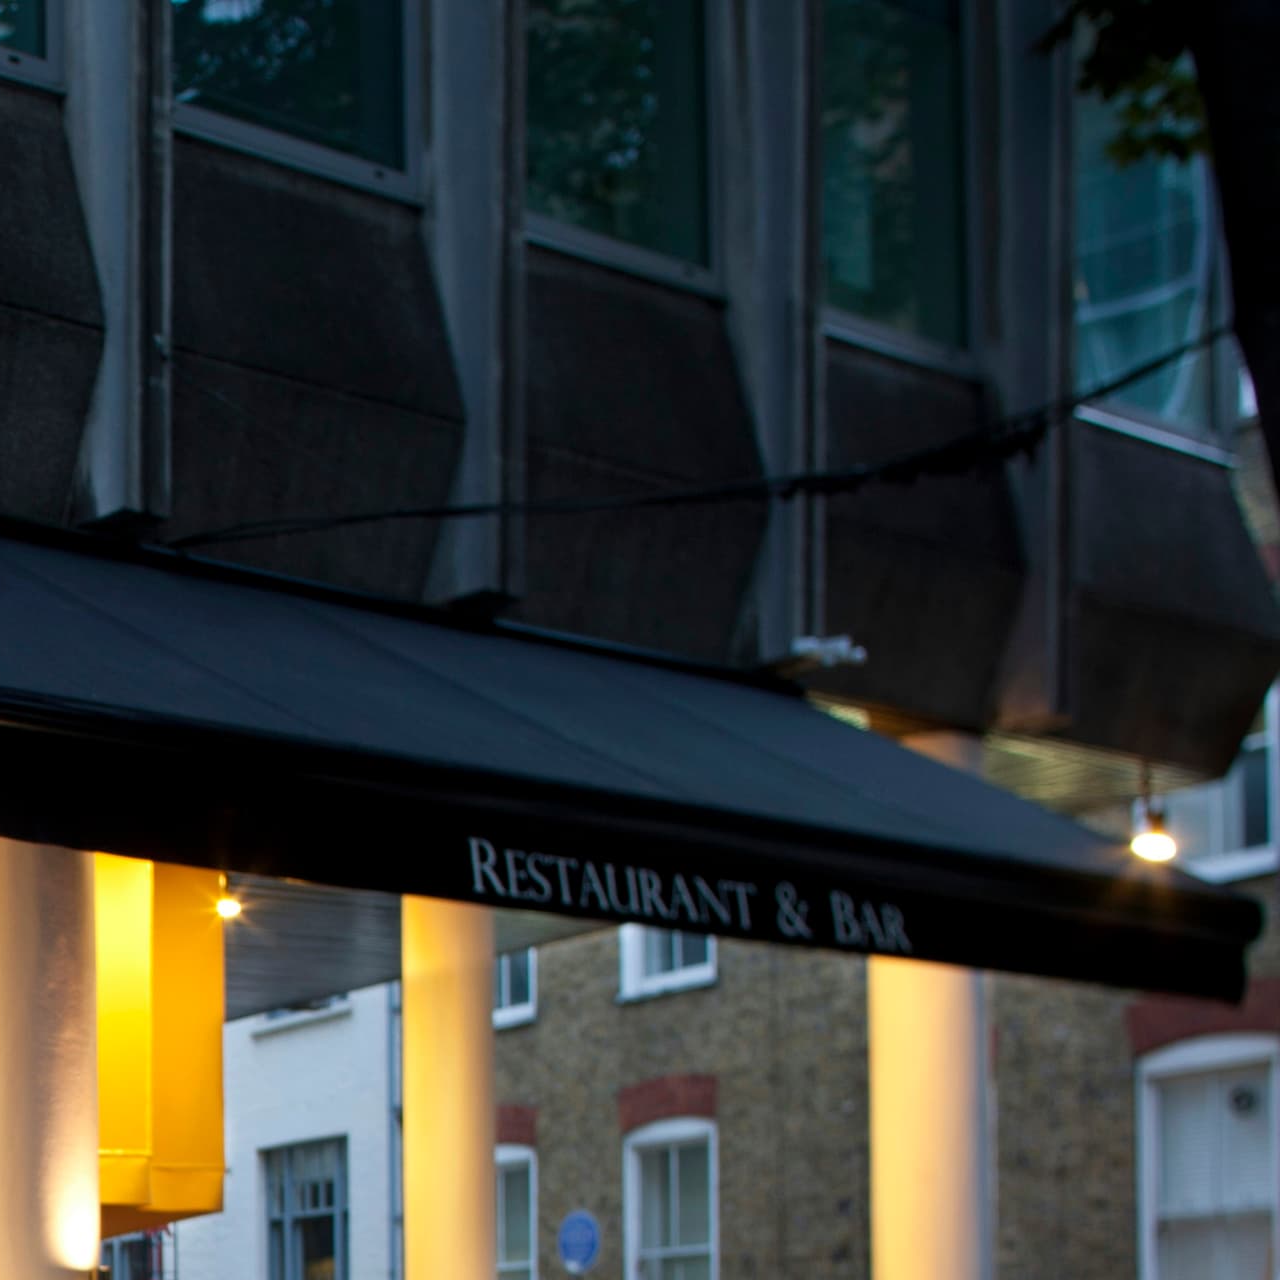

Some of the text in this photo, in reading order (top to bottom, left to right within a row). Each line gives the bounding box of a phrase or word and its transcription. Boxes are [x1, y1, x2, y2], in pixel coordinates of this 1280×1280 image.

[468, 836, 914, 954] RESTAURANT & BAR
